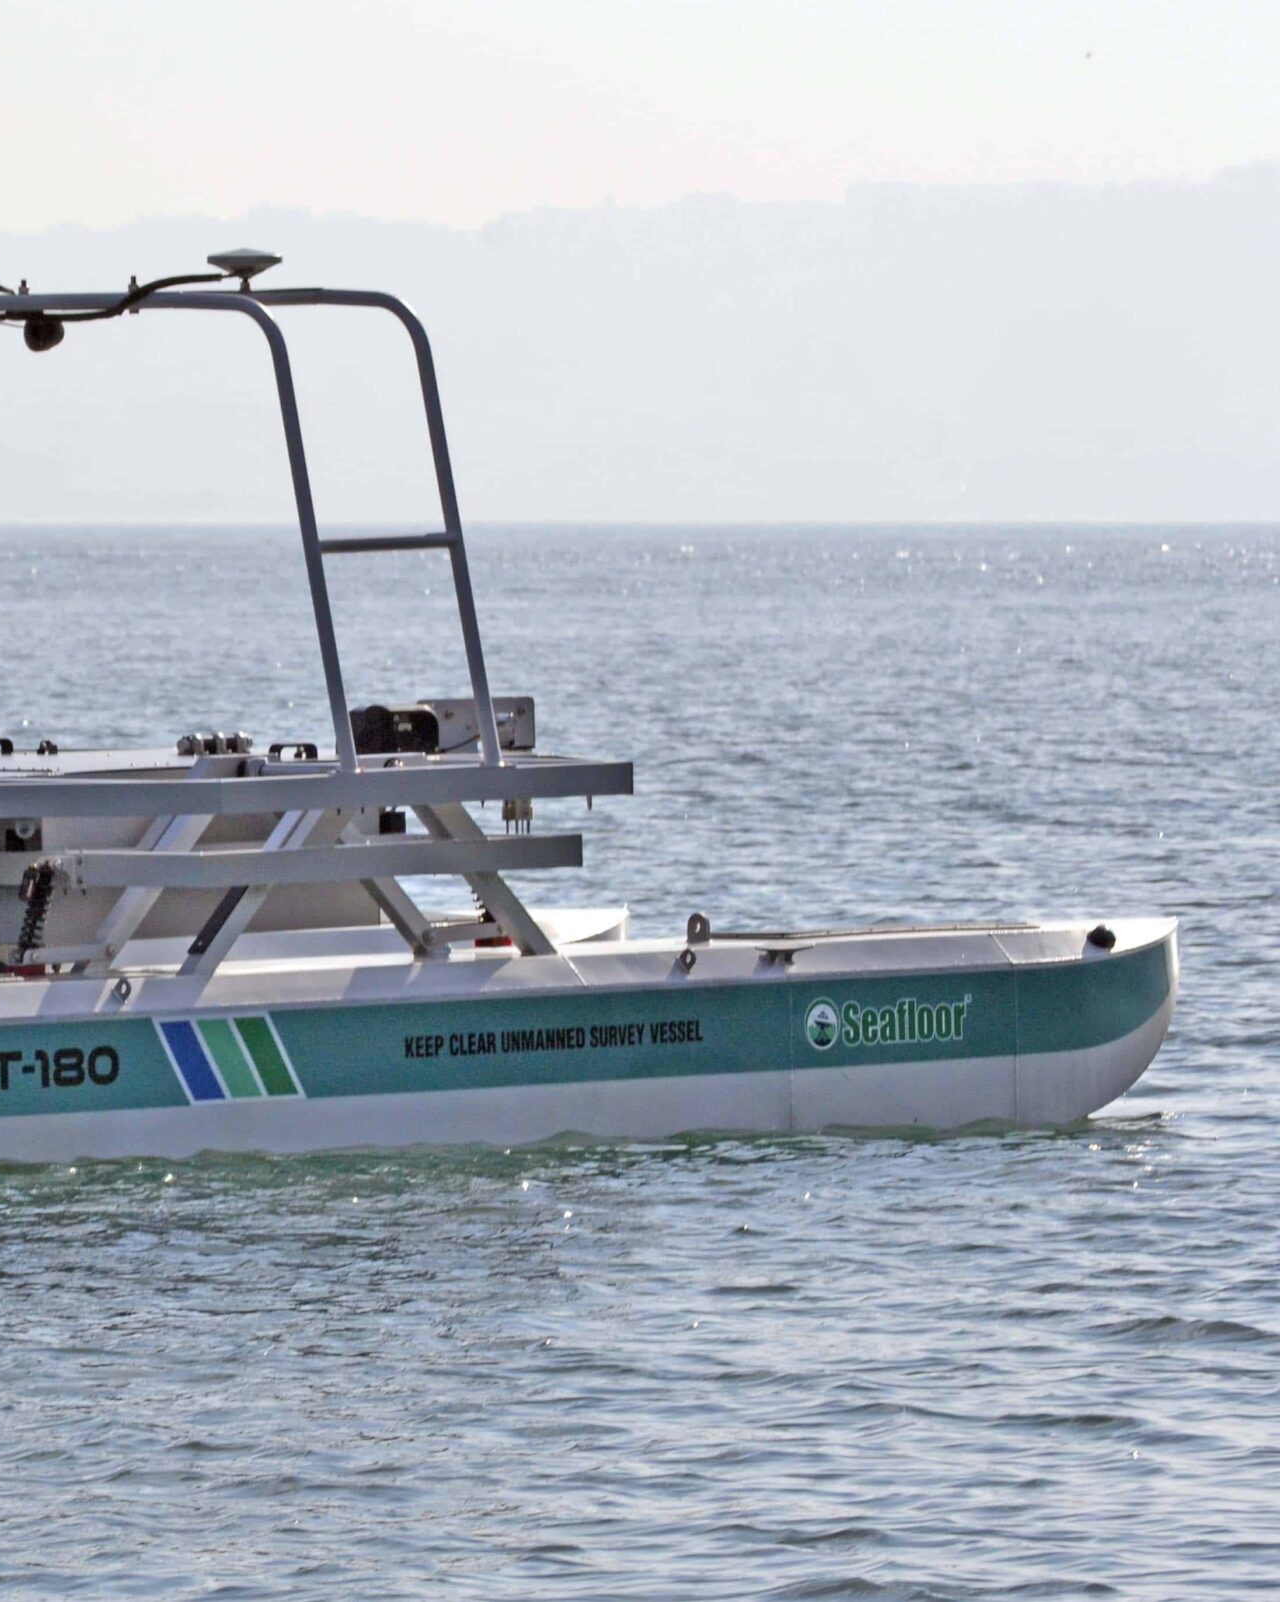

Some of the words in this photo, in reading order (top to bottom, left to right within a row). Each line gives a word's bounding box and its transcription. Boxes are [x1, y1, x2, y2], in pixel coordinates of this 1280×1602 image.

[404, 1035, 444, 1058] KEEP
[449, 1032, 496, 1056] CLEAR
[501, 1027, 585, 1053] UNMANNED
[590, 1024, 645, 1048] SURVEY
[650, 1019, 703, 1043] VESSEL
[841, 997, 967, 1047] Seafloor
